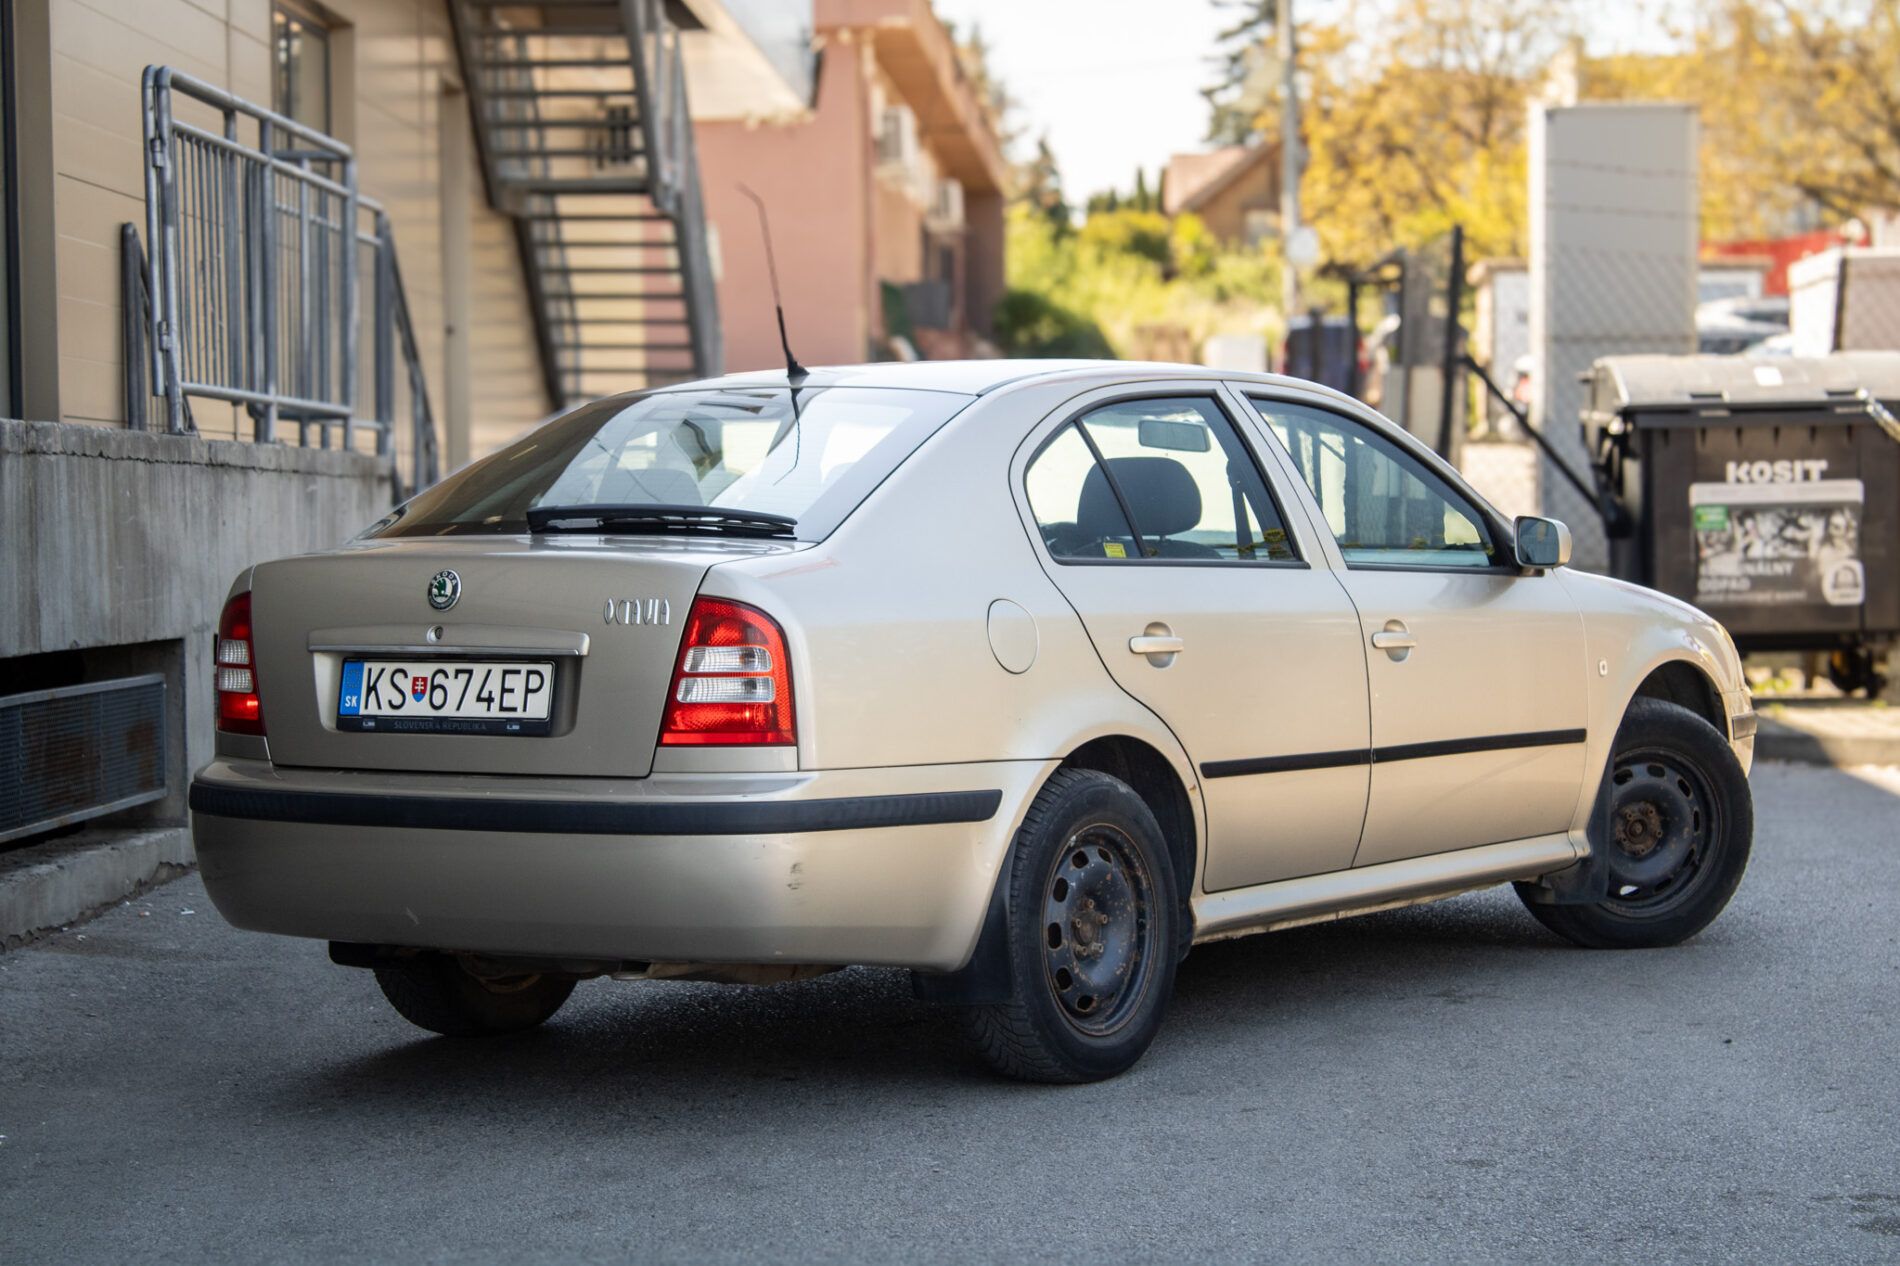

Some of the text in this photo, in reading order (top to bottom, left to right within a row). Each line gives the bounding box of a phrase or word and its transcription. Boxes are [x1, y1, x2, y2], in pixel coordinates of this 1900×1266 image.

[1725, 459, 1828, 482] KOSIT
[603, 598, 670, 625] OCTAVIA
[345, 695, 358, 707] SK
[364, 667, 545, 712] KS 674EP
